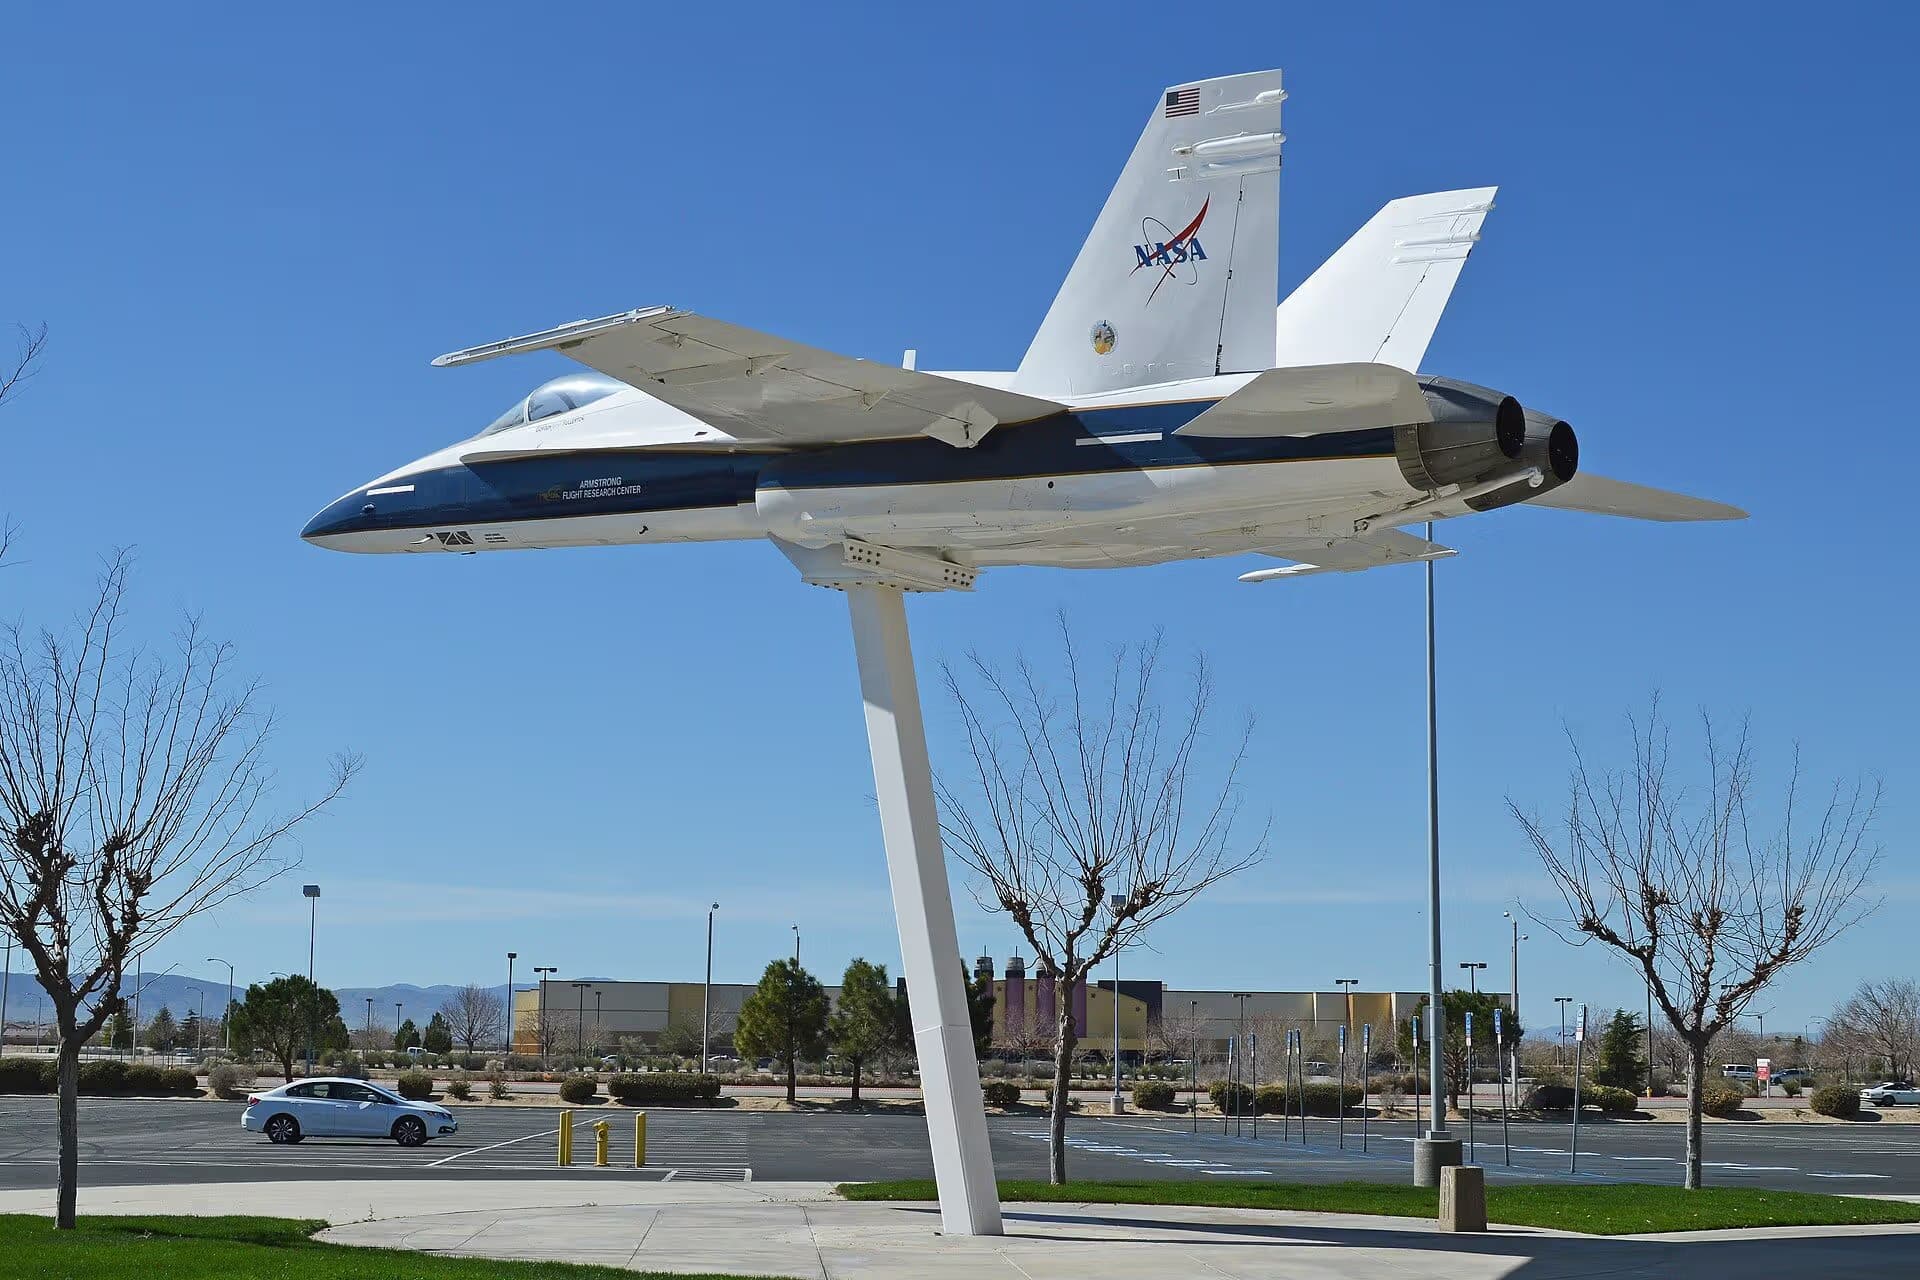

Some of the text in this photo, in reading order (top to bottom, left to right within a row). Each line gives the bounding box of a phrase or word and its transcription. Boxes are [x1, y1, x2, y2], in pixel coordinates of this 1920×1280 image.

[1134, 238, 1208, 267] NASA
[579, 477, 622, 489] ARMSTRONG
[562, 485, 641, 500] FLIGHT RESEARCH CENTER
